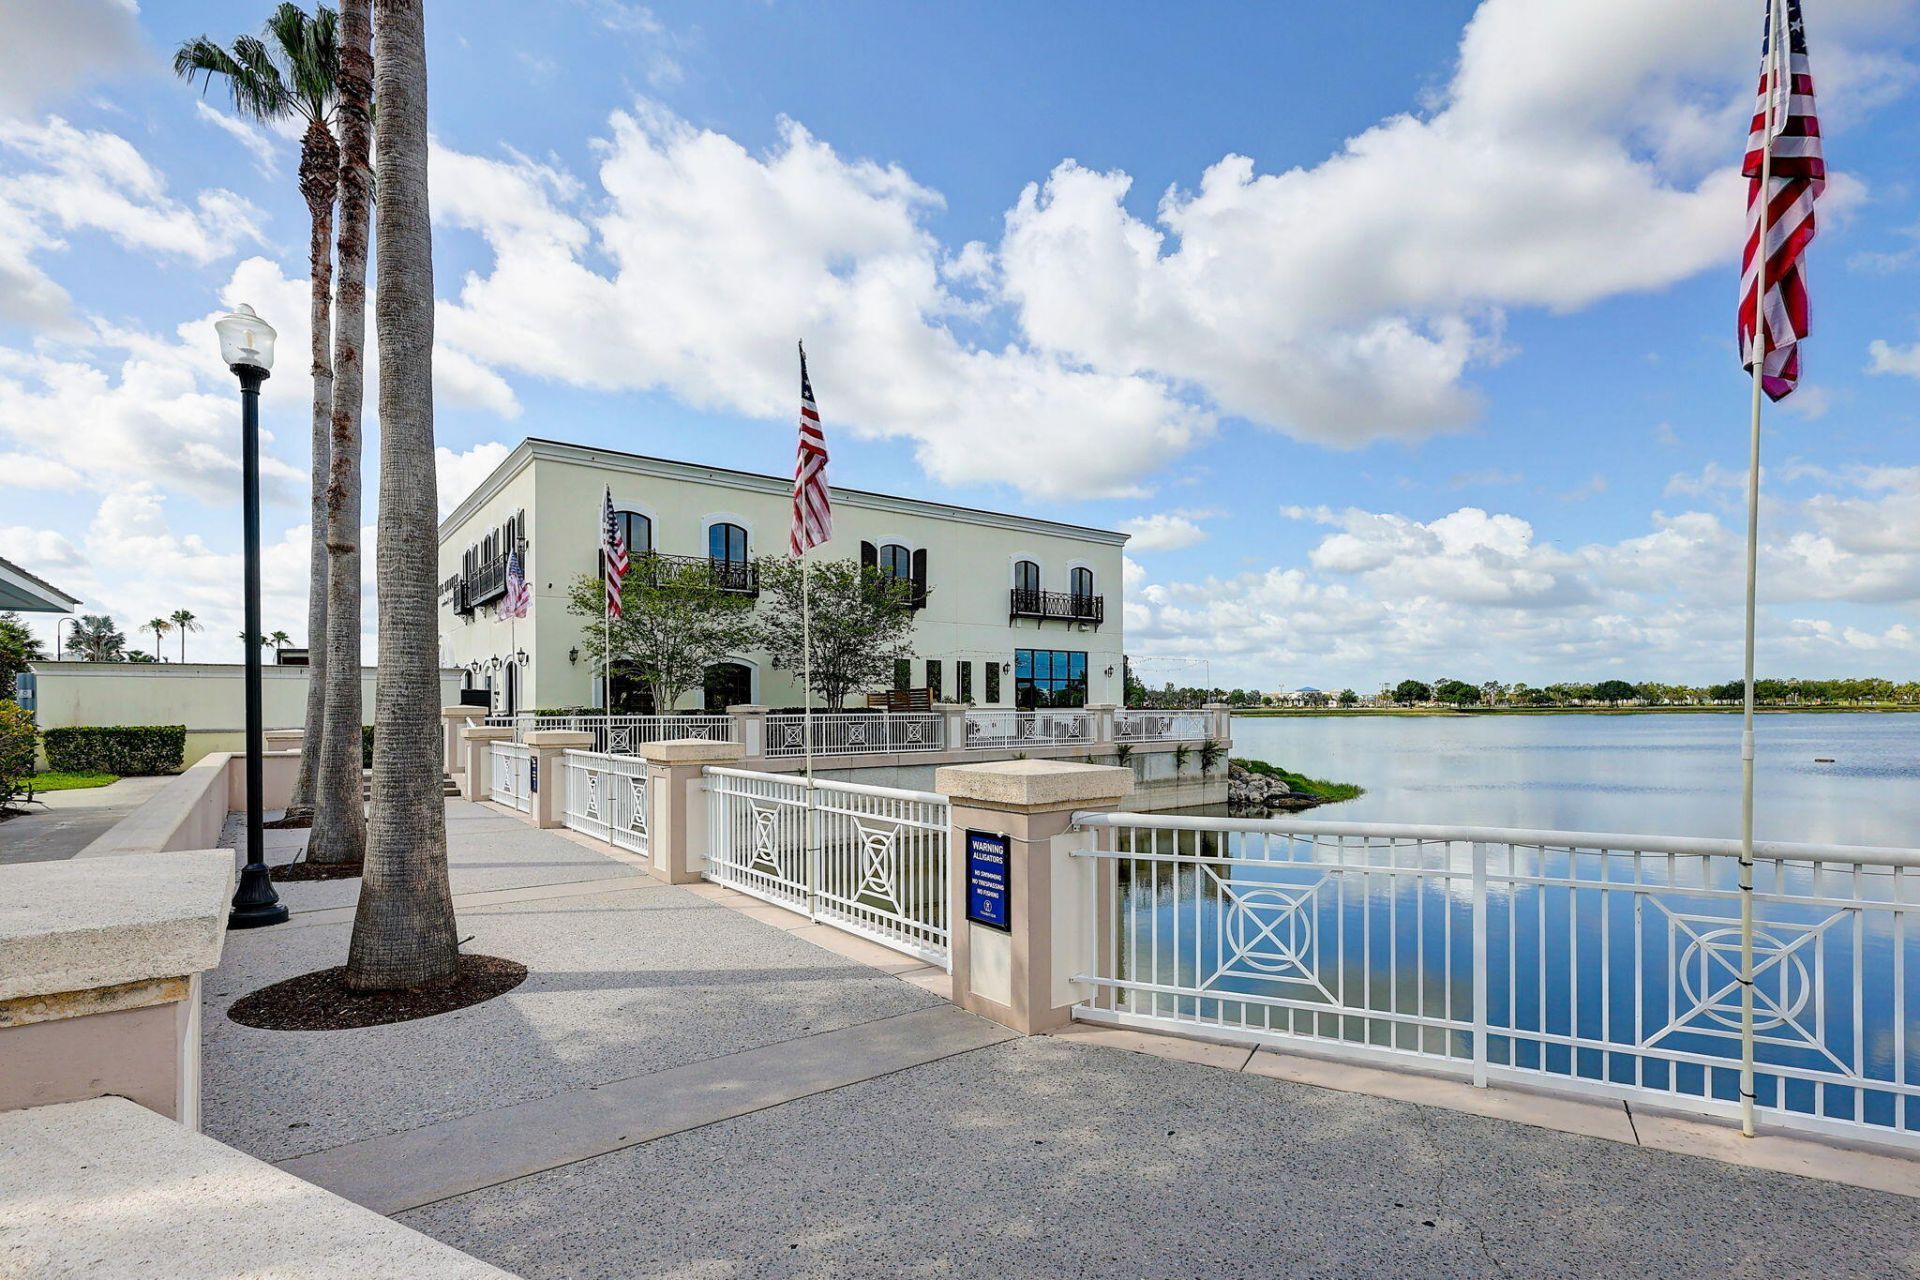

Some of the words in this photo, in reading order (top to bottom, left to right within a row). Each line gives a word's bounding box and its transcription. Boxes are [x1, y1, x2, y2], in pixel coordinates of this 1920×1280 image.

[973, 841, 1004, 854] WARNING
[973, 852, 1003, 864] ALLIGATORS
[979, 879, 1005, 890] TRESPASSING
[983, 889, 999, 899] FISHING
